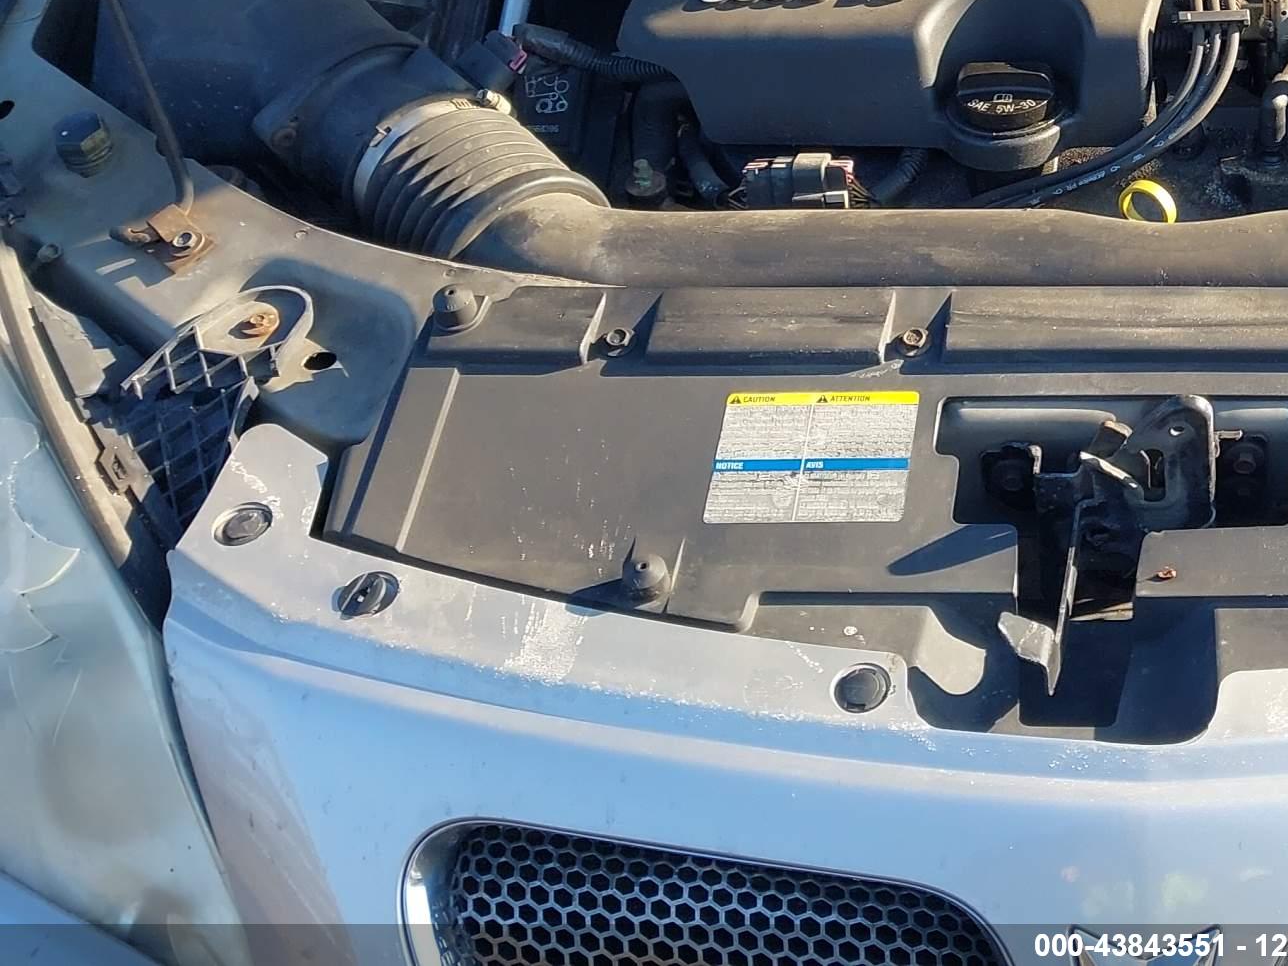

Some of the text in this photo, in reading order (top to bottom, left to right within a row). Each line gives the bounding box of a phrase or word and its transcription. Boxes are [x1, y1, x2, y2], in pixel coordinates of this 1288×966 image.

[967, 99, 1036, 114] SAE 5W-30
[715, 461, 744, 470] NOTICE
[805, 461, 824, 469] AVIS
